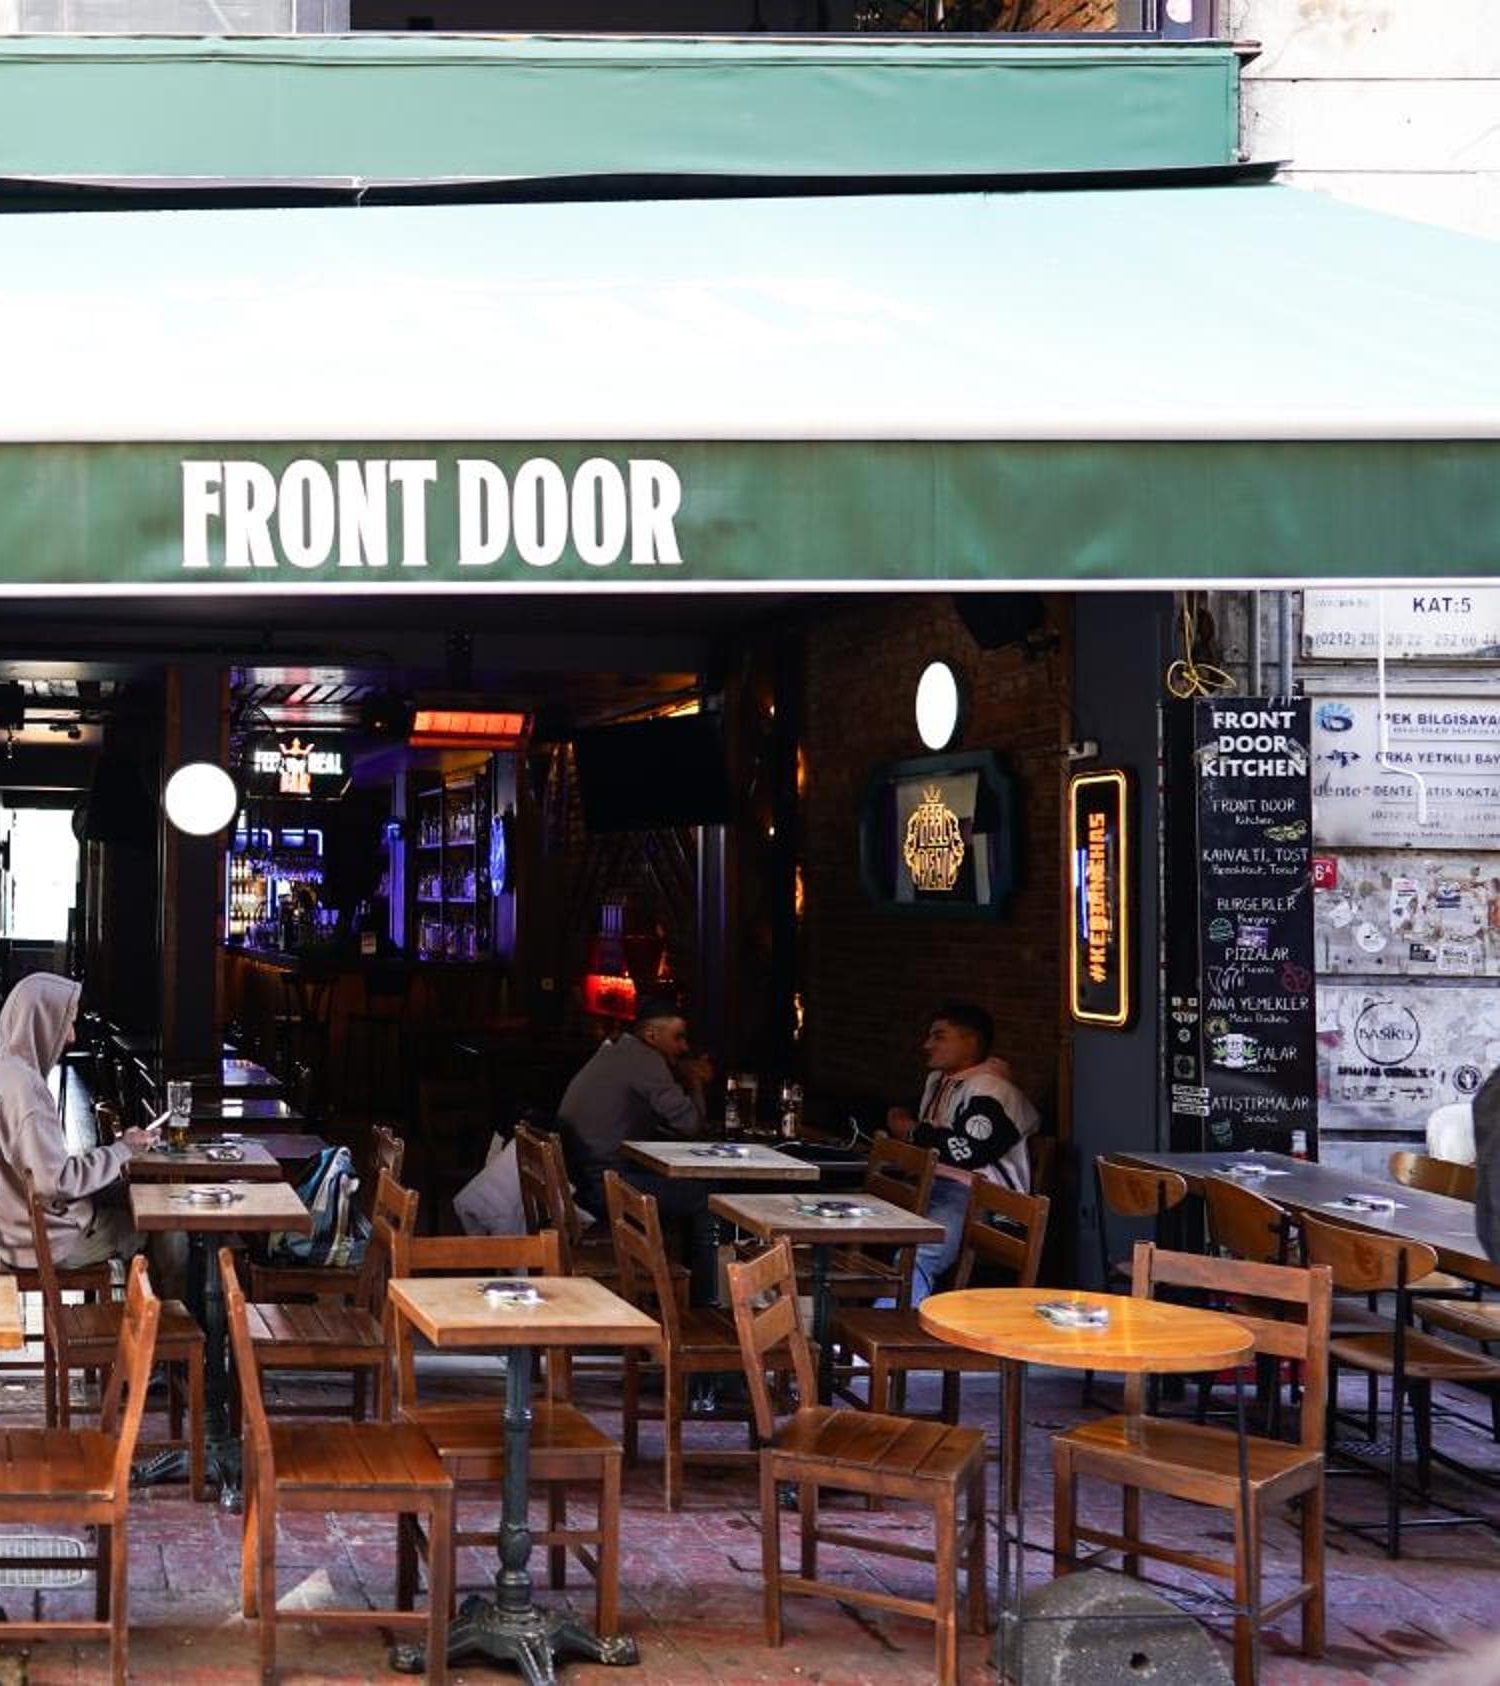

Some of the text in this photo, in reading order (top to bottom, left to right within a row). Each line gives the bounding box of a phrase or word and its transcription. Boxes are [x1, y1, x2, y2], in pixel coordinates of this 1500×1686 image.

[181, 458, 682, 568] FRONT DOOR
[1413, 597, 1471, 613] KAT:5
[1212, 711, 1297, 729] FRONT
[1219, 735, 1288, 753] DOOR
[1201, 759, 1307, 777] KITCHEN
[1261, 799, 1295, 813] DOOR
[1274, 848, 1309, 862] TOST
[1216, 897, 1297, 911] BURGERLER
[1207, 997, 1309, 1011] ANA YEMEKLER
